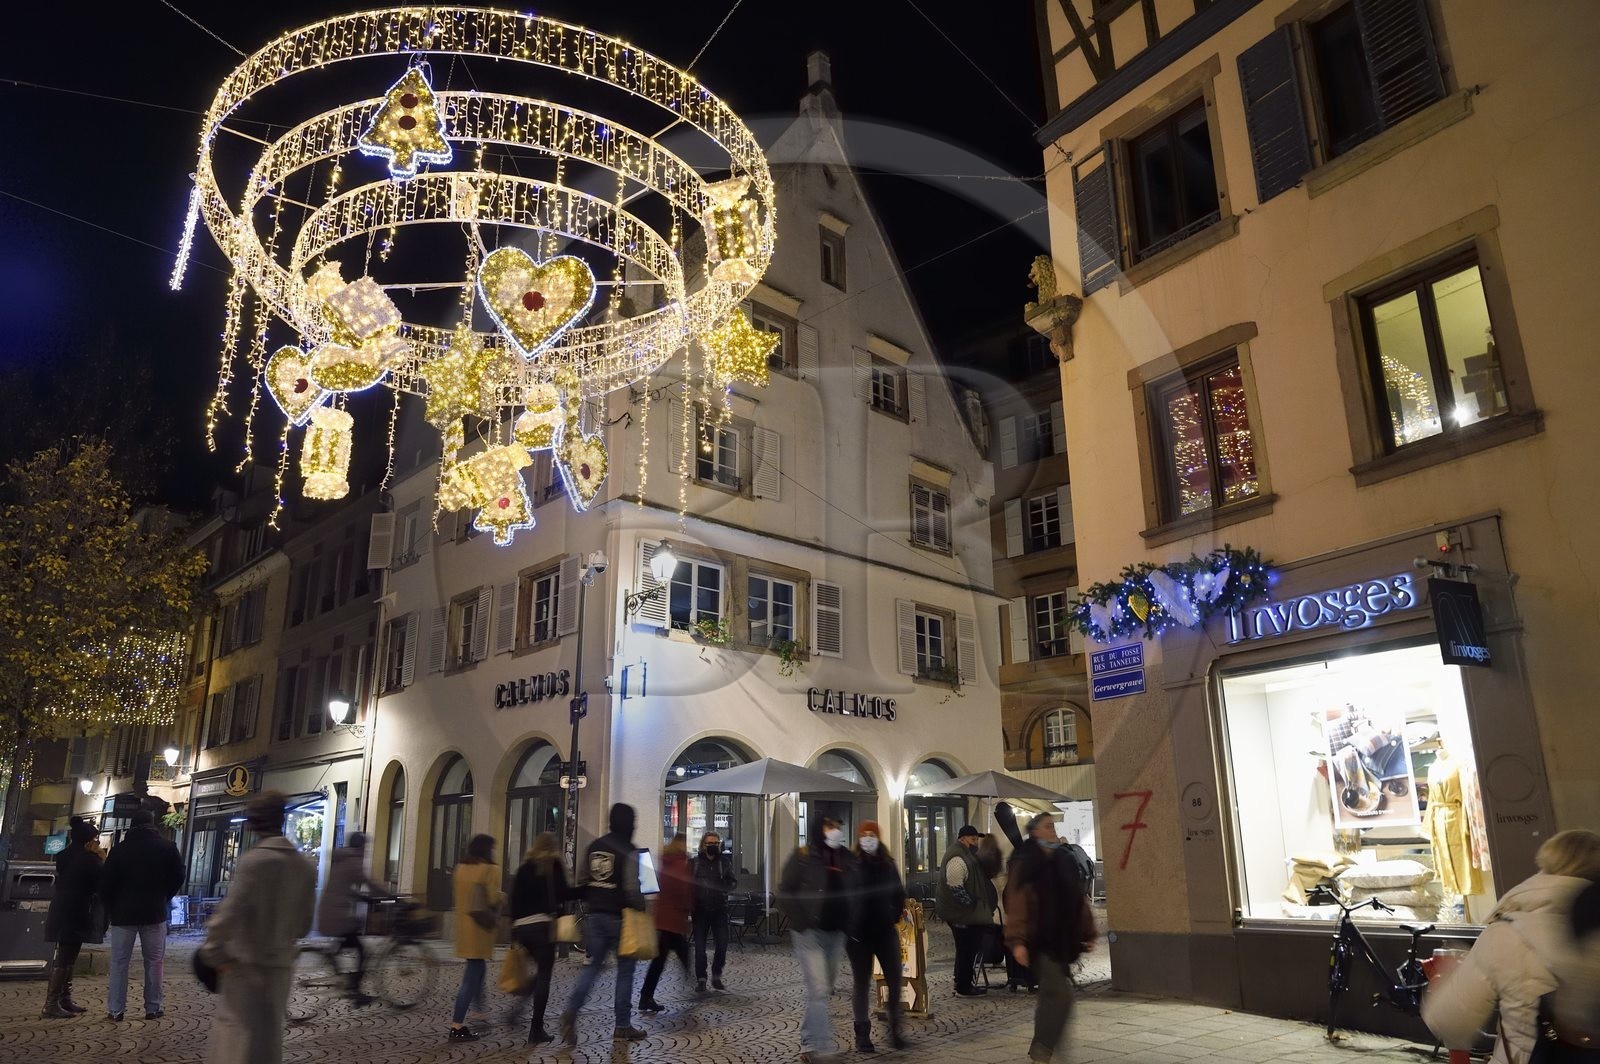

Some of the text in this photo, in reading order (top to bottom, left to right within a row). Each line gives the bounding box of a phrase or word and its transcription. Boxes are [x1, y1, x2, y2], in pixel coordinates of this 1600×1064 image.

[1093, 655, 1105, 663] RUE
[1109, 652, 1117, 660] DU
[1094, 656, 1140, 672] DES TANNEURS
[495, 669, 570, 709] CALMOS
[1095, 679, 1142, 692] Gerwergrawe
[807, 687, 896, 721] CALMOS
[1114, 790, 1153, 870] 7
